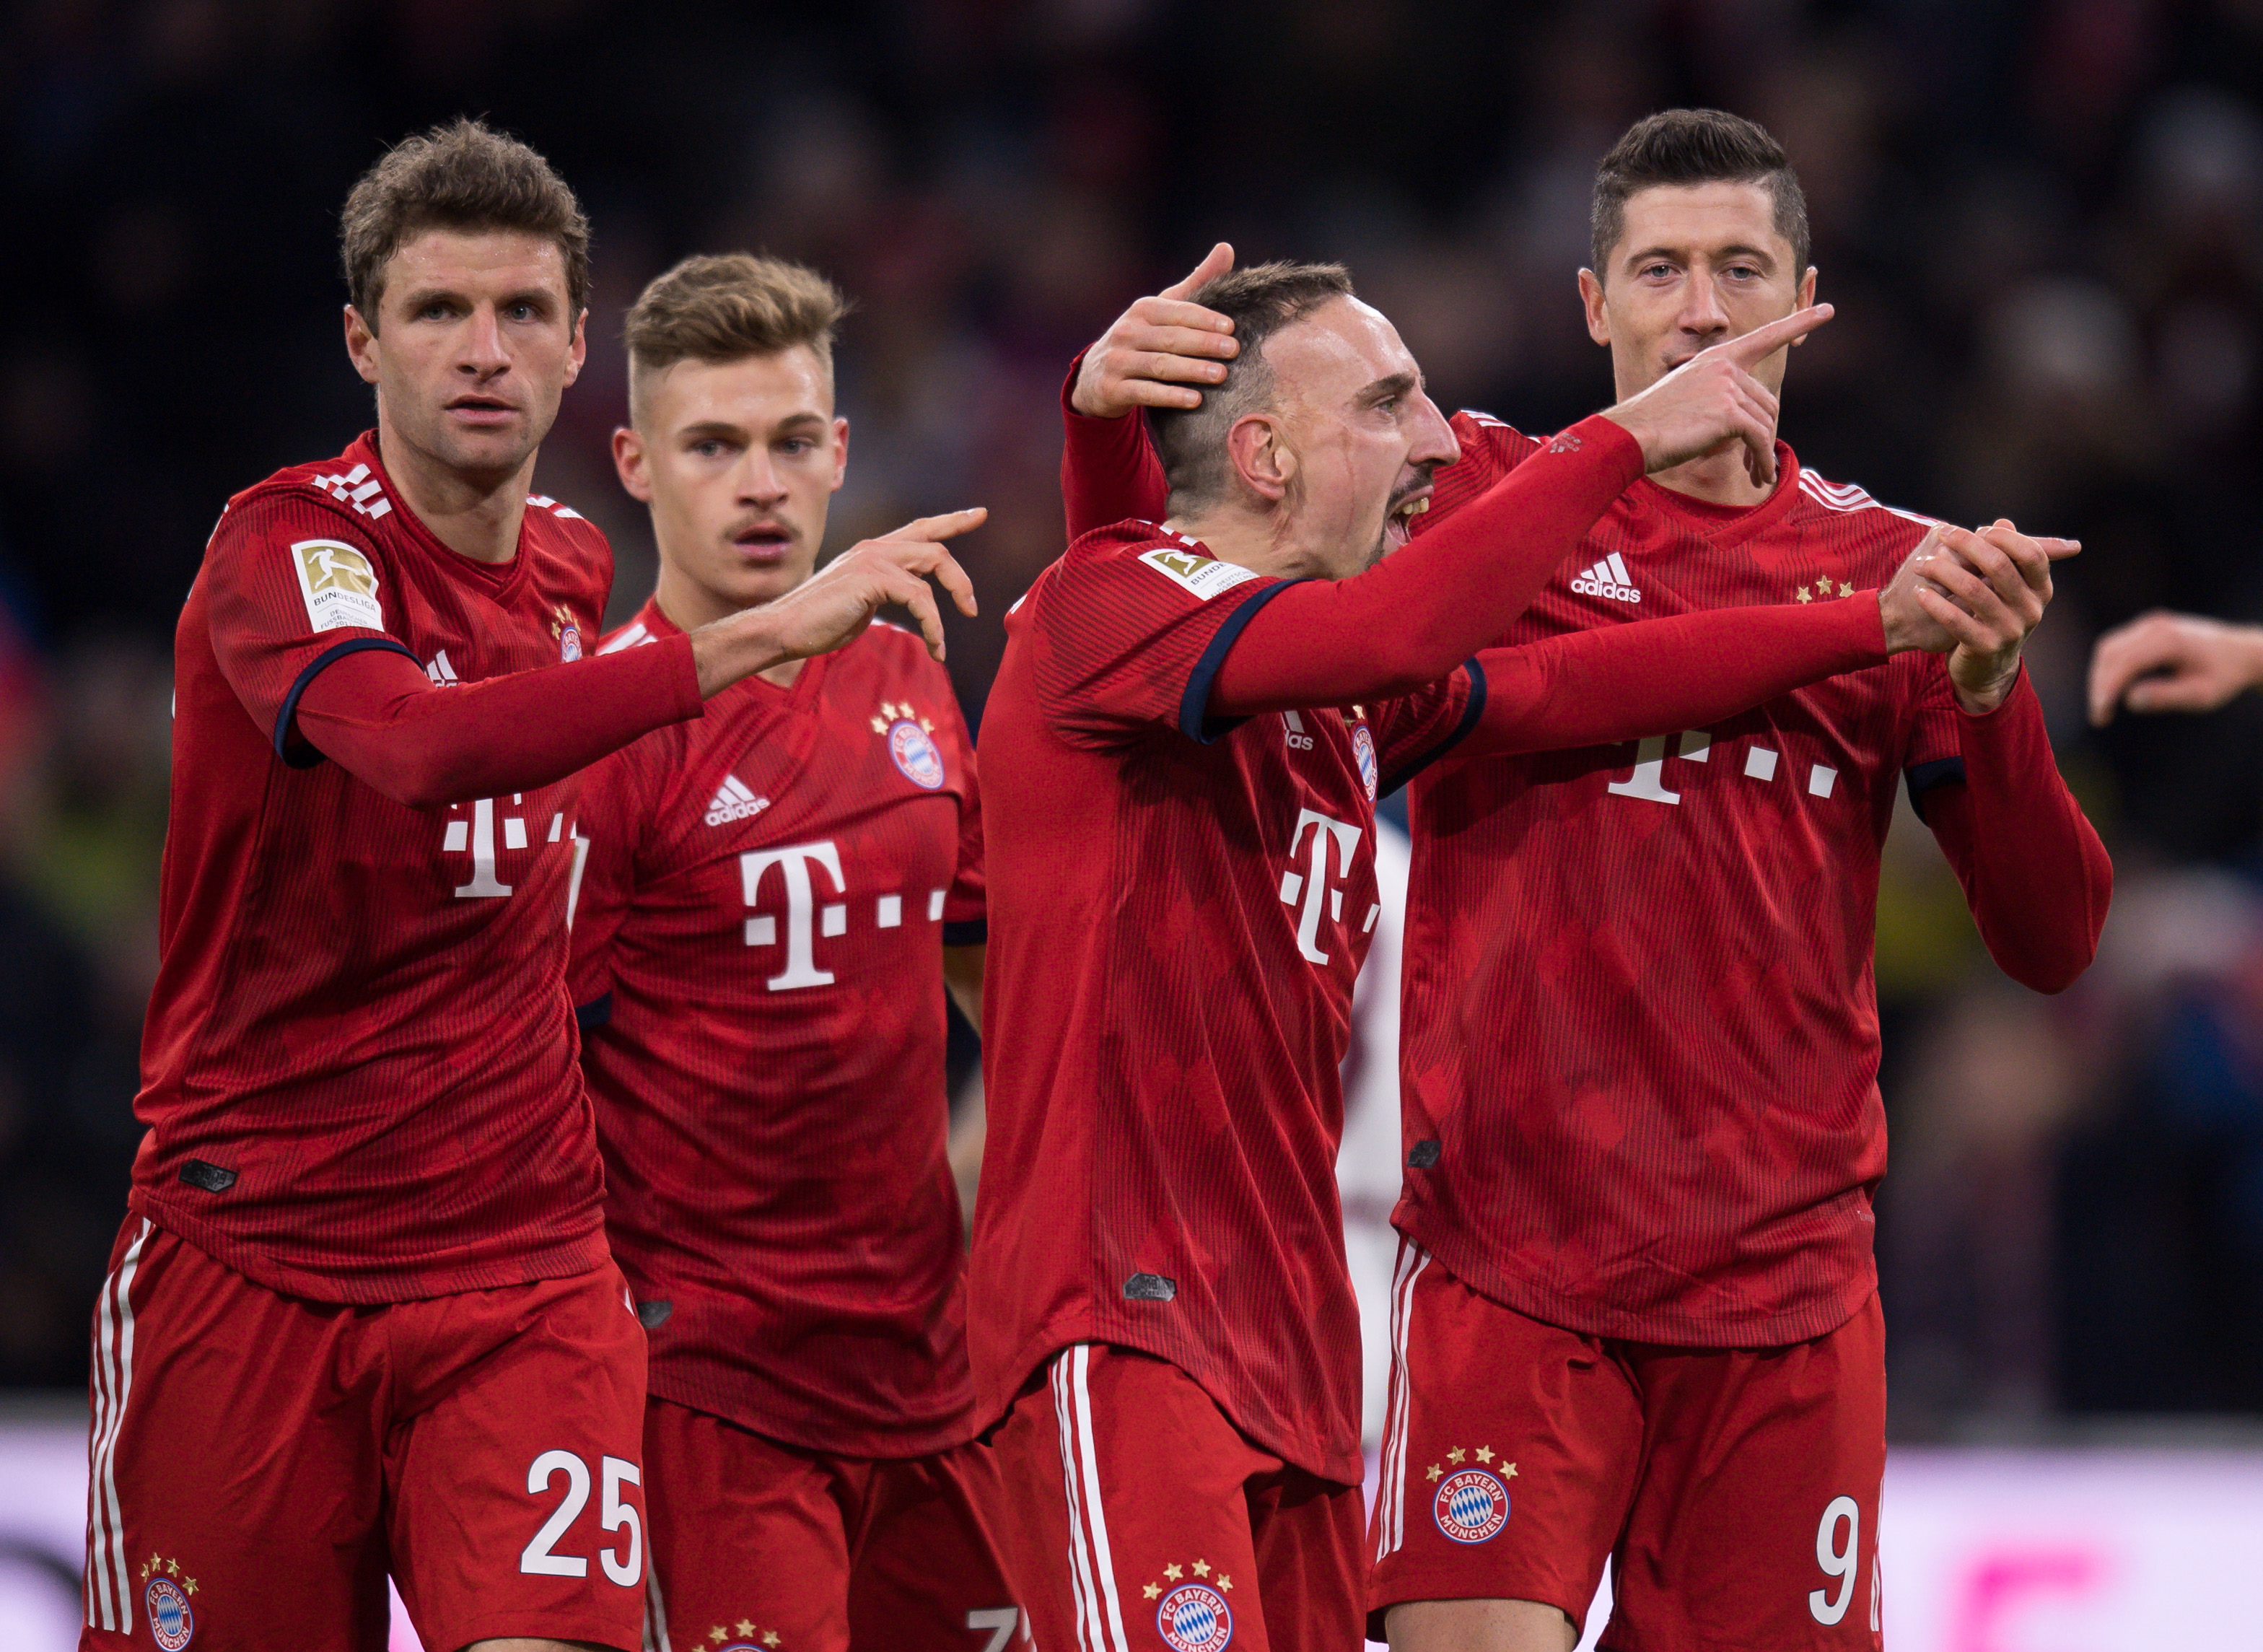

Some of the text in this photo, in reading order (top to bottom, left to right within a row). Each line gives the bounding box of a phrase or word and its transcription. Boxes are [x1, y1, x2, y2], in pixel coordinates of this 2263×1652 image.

[1191, 562, 1227, 585] BUNDE
[314, 592, 376, 613] BUNDESLIGA
[1571, 580, 1641, 603] adidas
[705, 798, 771, 826] adidas
[1440, 1474, 1504, 1503] FC BAYERN
[519, 1448, 643, 1588] 25
[1808, 1495, 1860, 1627] 9
[150, 1584, 188, 1614] FC BAYERN
[1163, 1588, 1225, 1620] FC BAYERN
